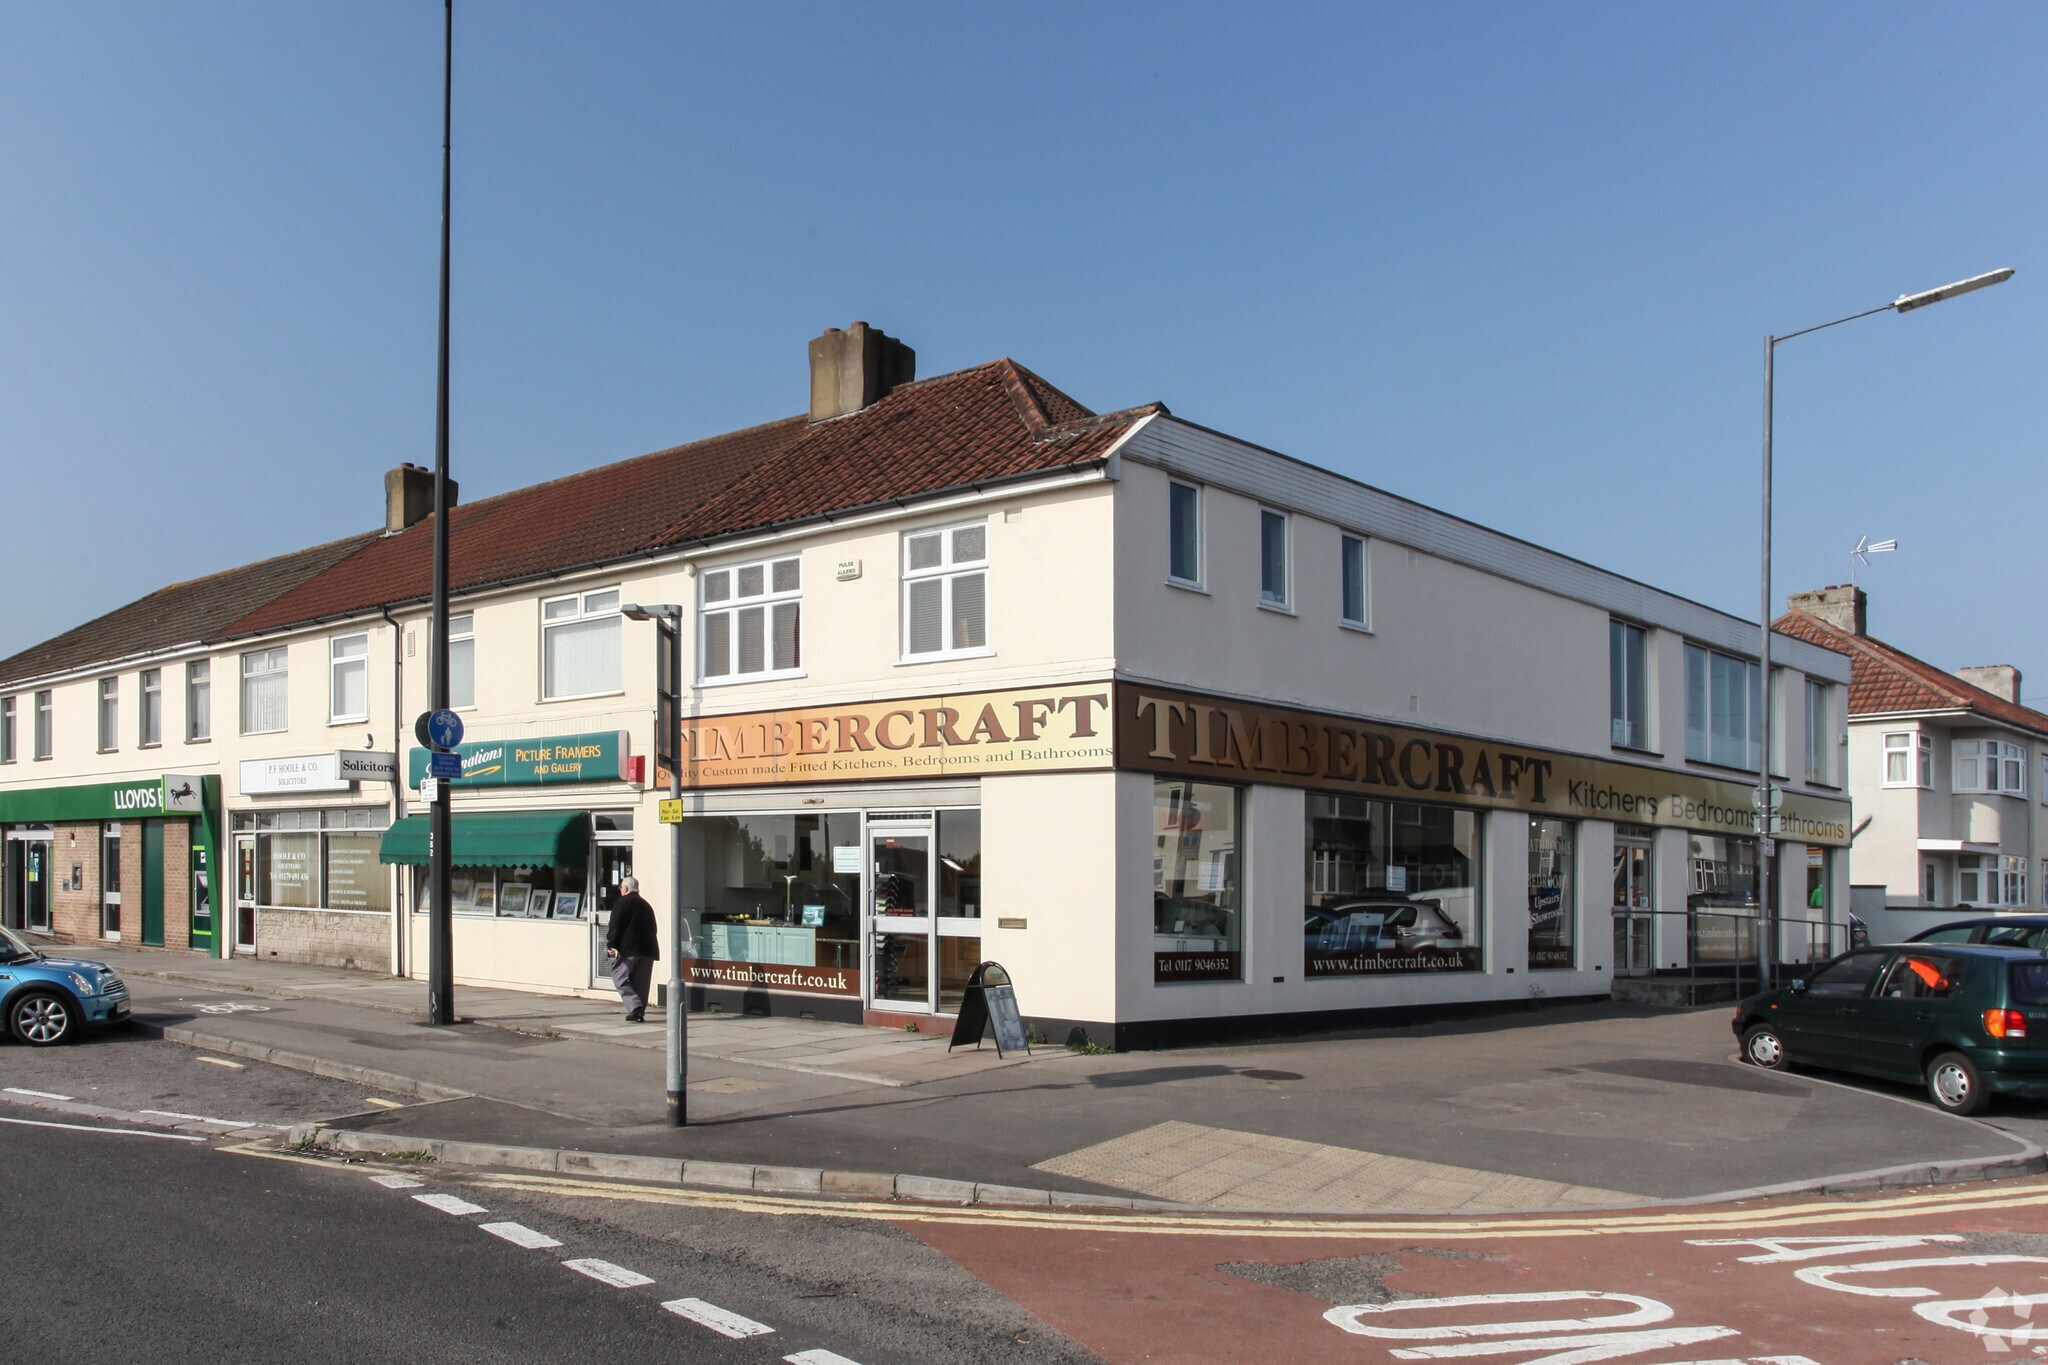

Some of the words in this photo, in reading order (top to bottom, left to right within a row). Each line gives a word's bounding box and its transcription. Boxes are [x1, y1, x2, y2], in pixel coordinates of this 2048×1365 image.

[837, 567, 856, 576] ALARMS
[838, 560, 854, 568] PULSE
[681, 693, 1109, 763] IMBERCRAFT
[515, 748, 552, 763] PICTURE
[555, 744, 601, 760] FRAMERS
[1136, 695, 1552, 803] TIMBERCRAFT
[279, 763, 300, 773] HOOLE
[301, 762, 307, 772] &
[342, 759, 395, 773] Solicitors
[534, 764, 549, 775] AND
[551, 762, 583, 774] GALLERY
[702, 766, 748, 778] Custom
[752, 763, 786, 775] made
[789, 760, 827, 773] Fitted
[832, 757, 897, 771] Kitchens,
[902, 754, 980, 768] Bedrooms
[985, 750, 1014, 763] and
[1020, 746, 1113, 761] Bathrooms
[277, 776, 308, 786] SOLICITORS
[114, 787, 157, 810] LLOYDS
[1568, 778, 1658, 816] Kitchens
[1671, 793, 1757, 828] Bedrooms
[1775, 812, 1845, 839] athrooms
[1528, 838, 1571, 855] ATHROOMS
[1159, 959, 1172, 971] Tel
[1174, 959, 1192, 971] 0117
[1194, 958, 1229, 971] 9046352
[1313, 951, 1464, 971] www.timbercraft.co.uk
[690, 965, 848, 990] www.timbercraft.co.uk
